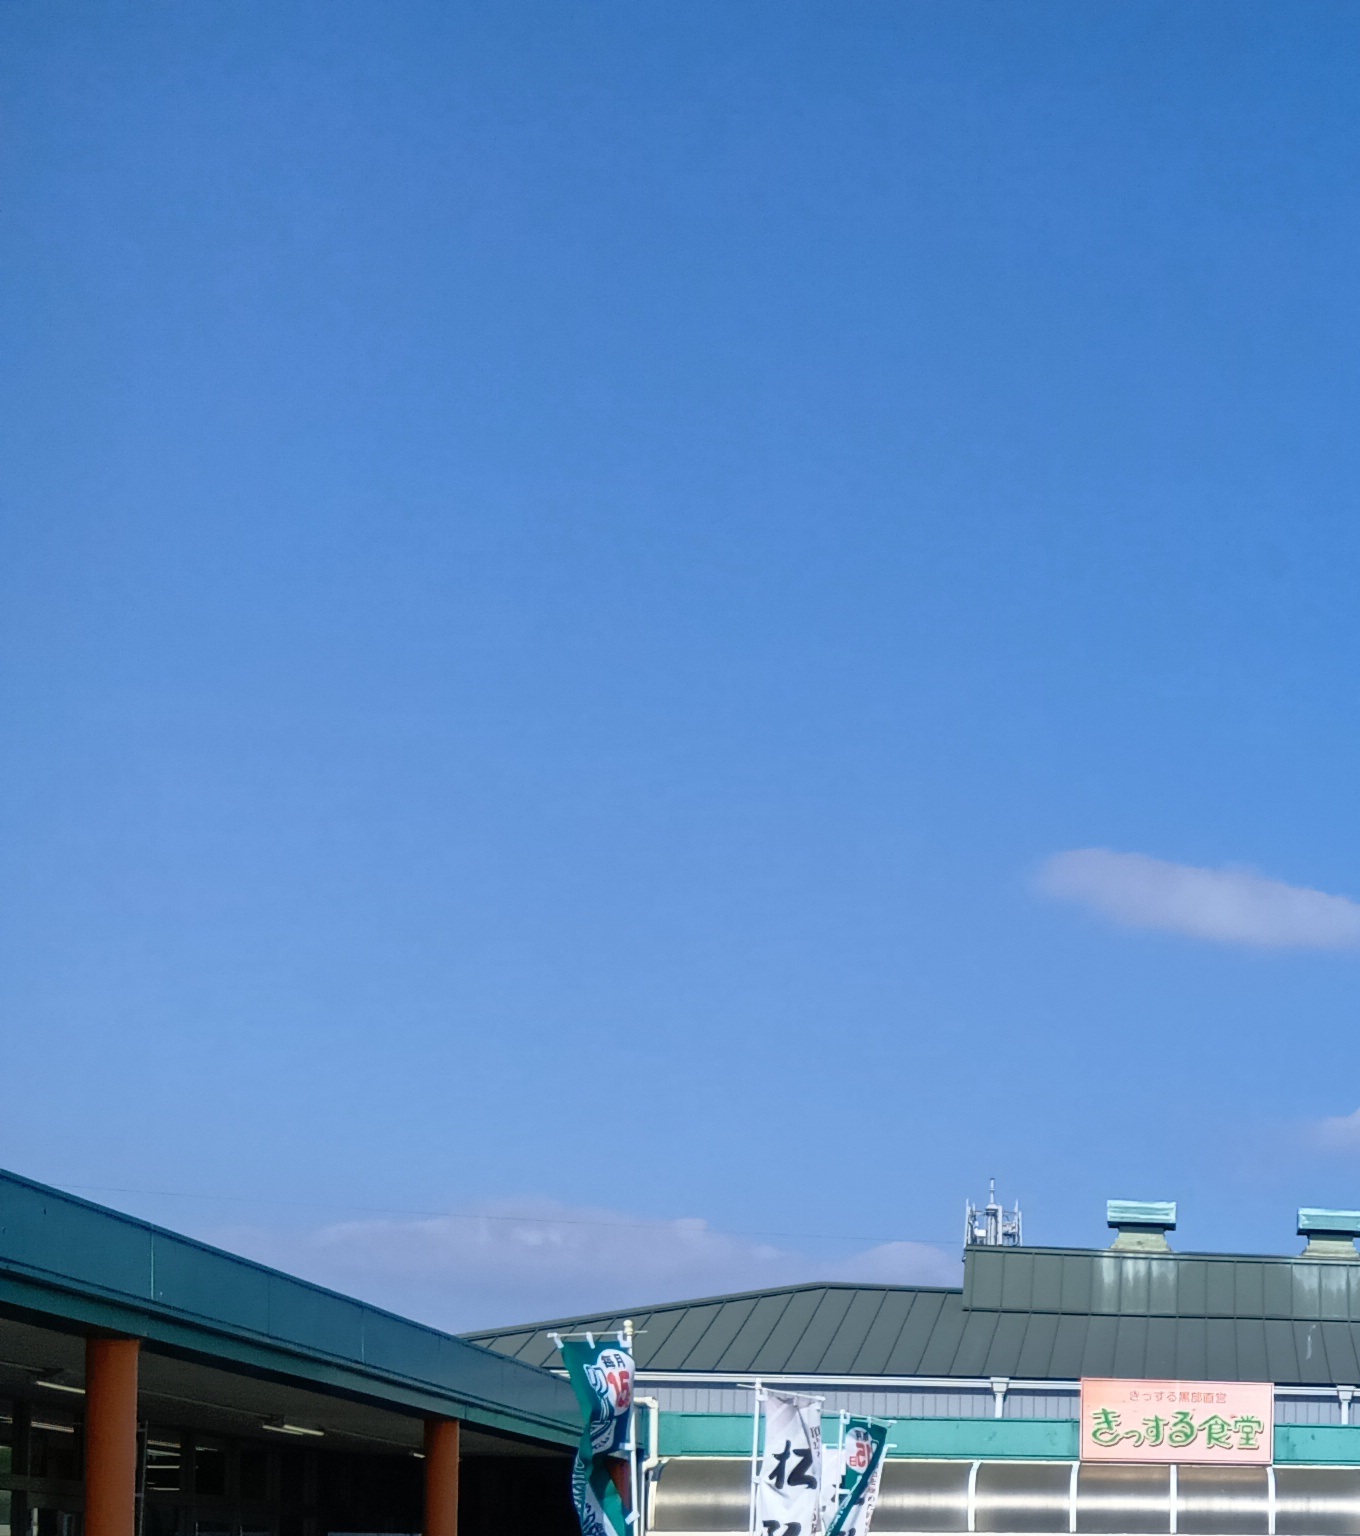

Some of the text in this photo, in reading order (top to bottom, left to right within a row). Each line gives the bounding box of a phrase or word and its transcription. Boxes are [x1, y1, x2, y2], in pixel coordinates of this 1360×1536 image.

[1091, 1407, 1265, 1451] きっする食堂
